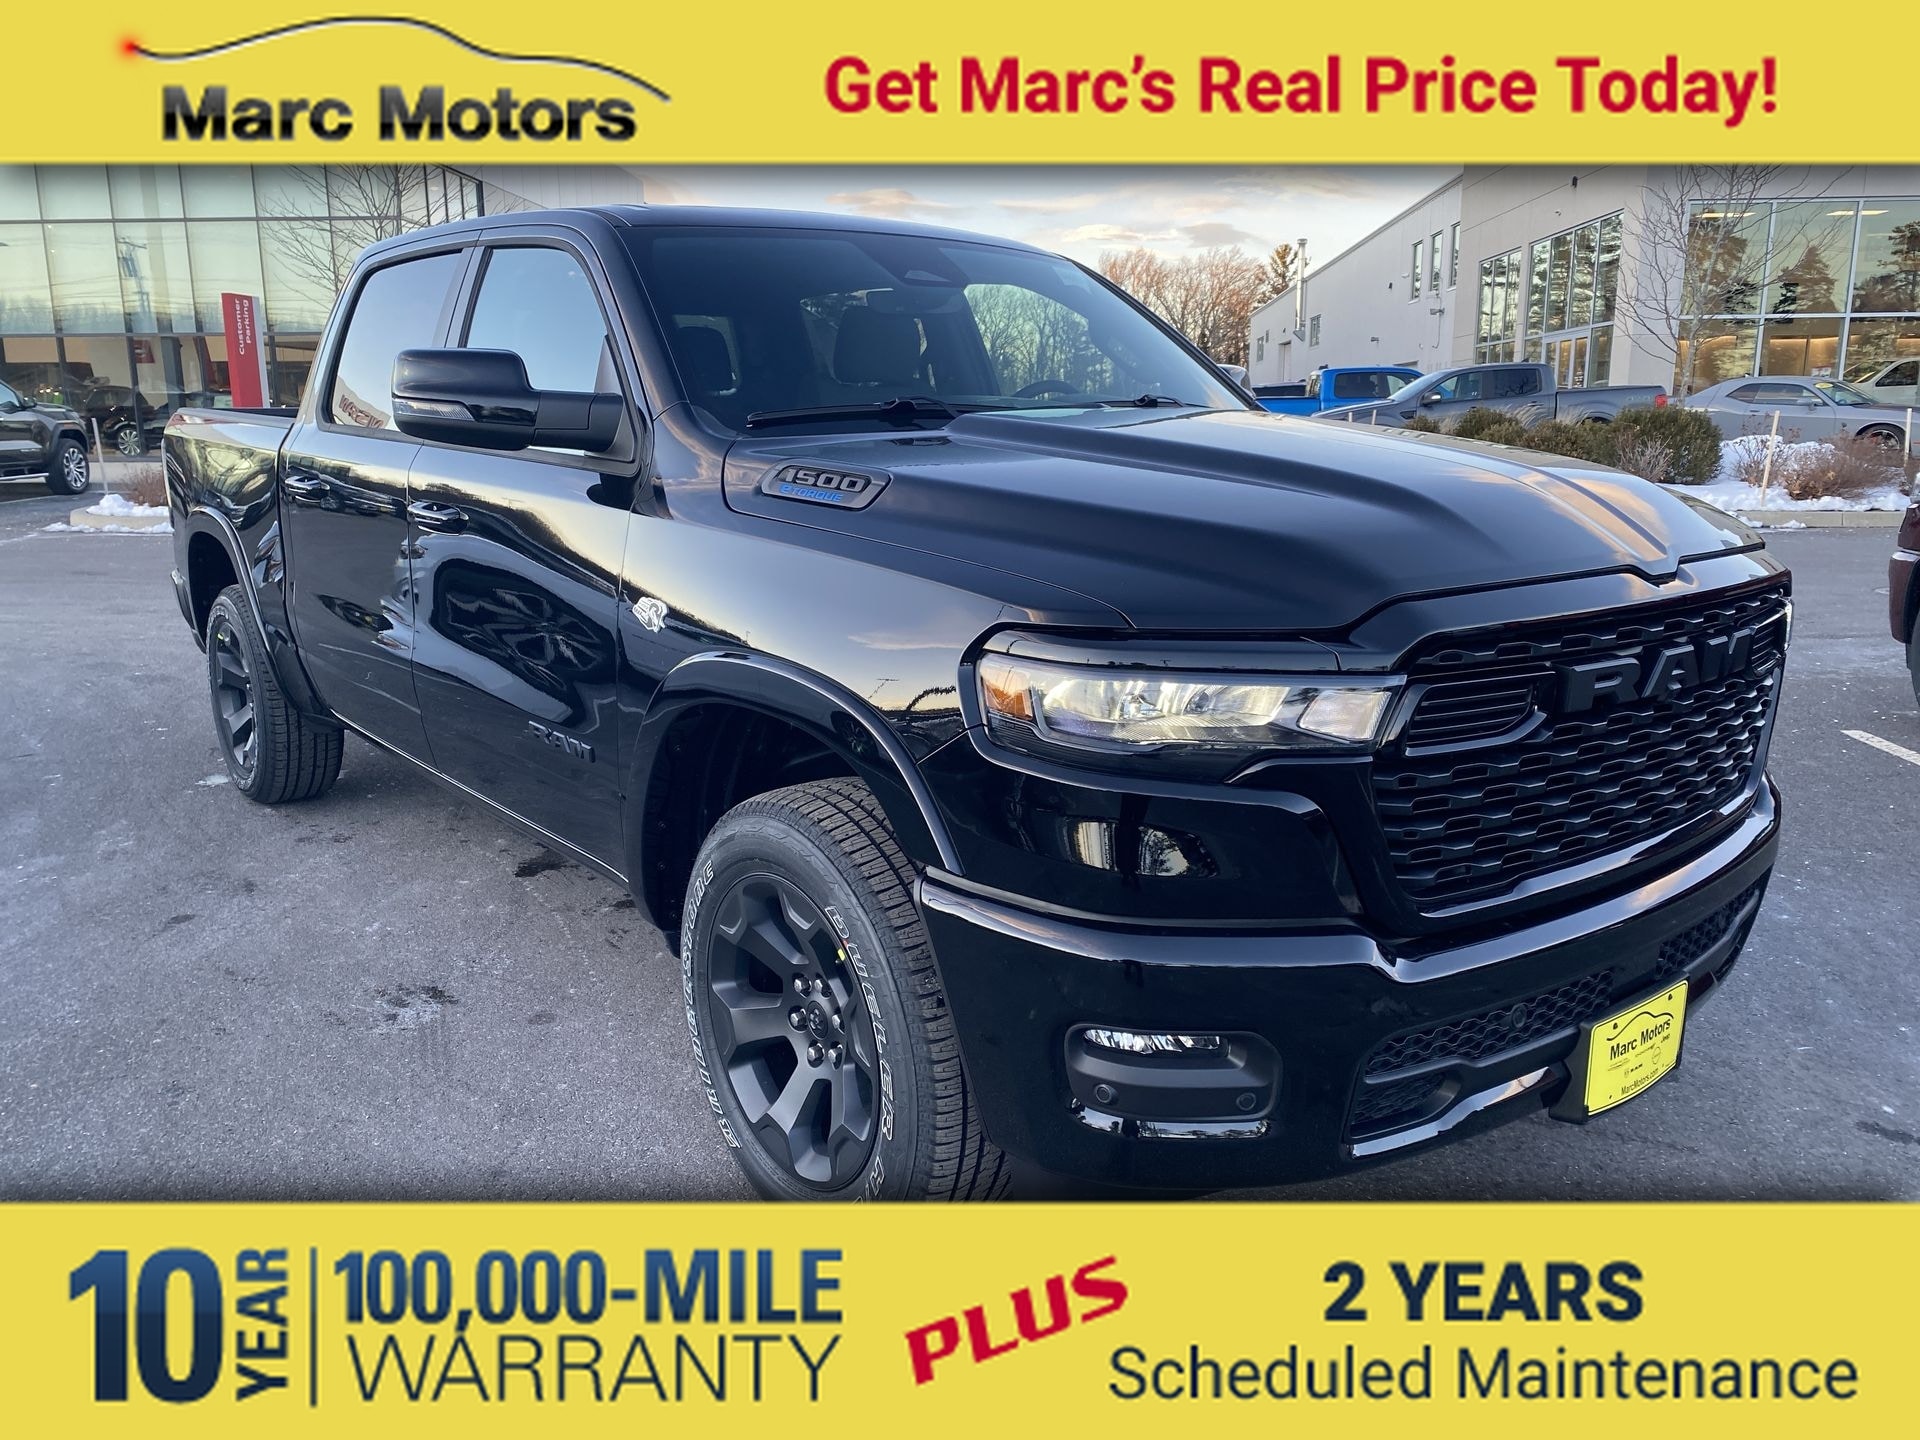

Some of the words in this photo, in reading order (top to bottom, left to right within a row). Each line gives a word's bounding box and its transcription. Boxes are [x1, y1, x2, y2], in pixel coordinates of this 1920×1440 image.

[235, 298, 245, 355] Customer
[243, 299, 252, 344] Parking
[784, 468, 866, 493] 1500
[1564, 627, 1757, 713] RAM
[527, 720, 596, 763] RAM
[824, 905, 893, 1141] DUELER
[1610, 1038, 1637, 1061] Marc
[1640, 1019, 1671, 1046] Motors
[1621, 1068, 1659, 1095] MarcMotors.com
